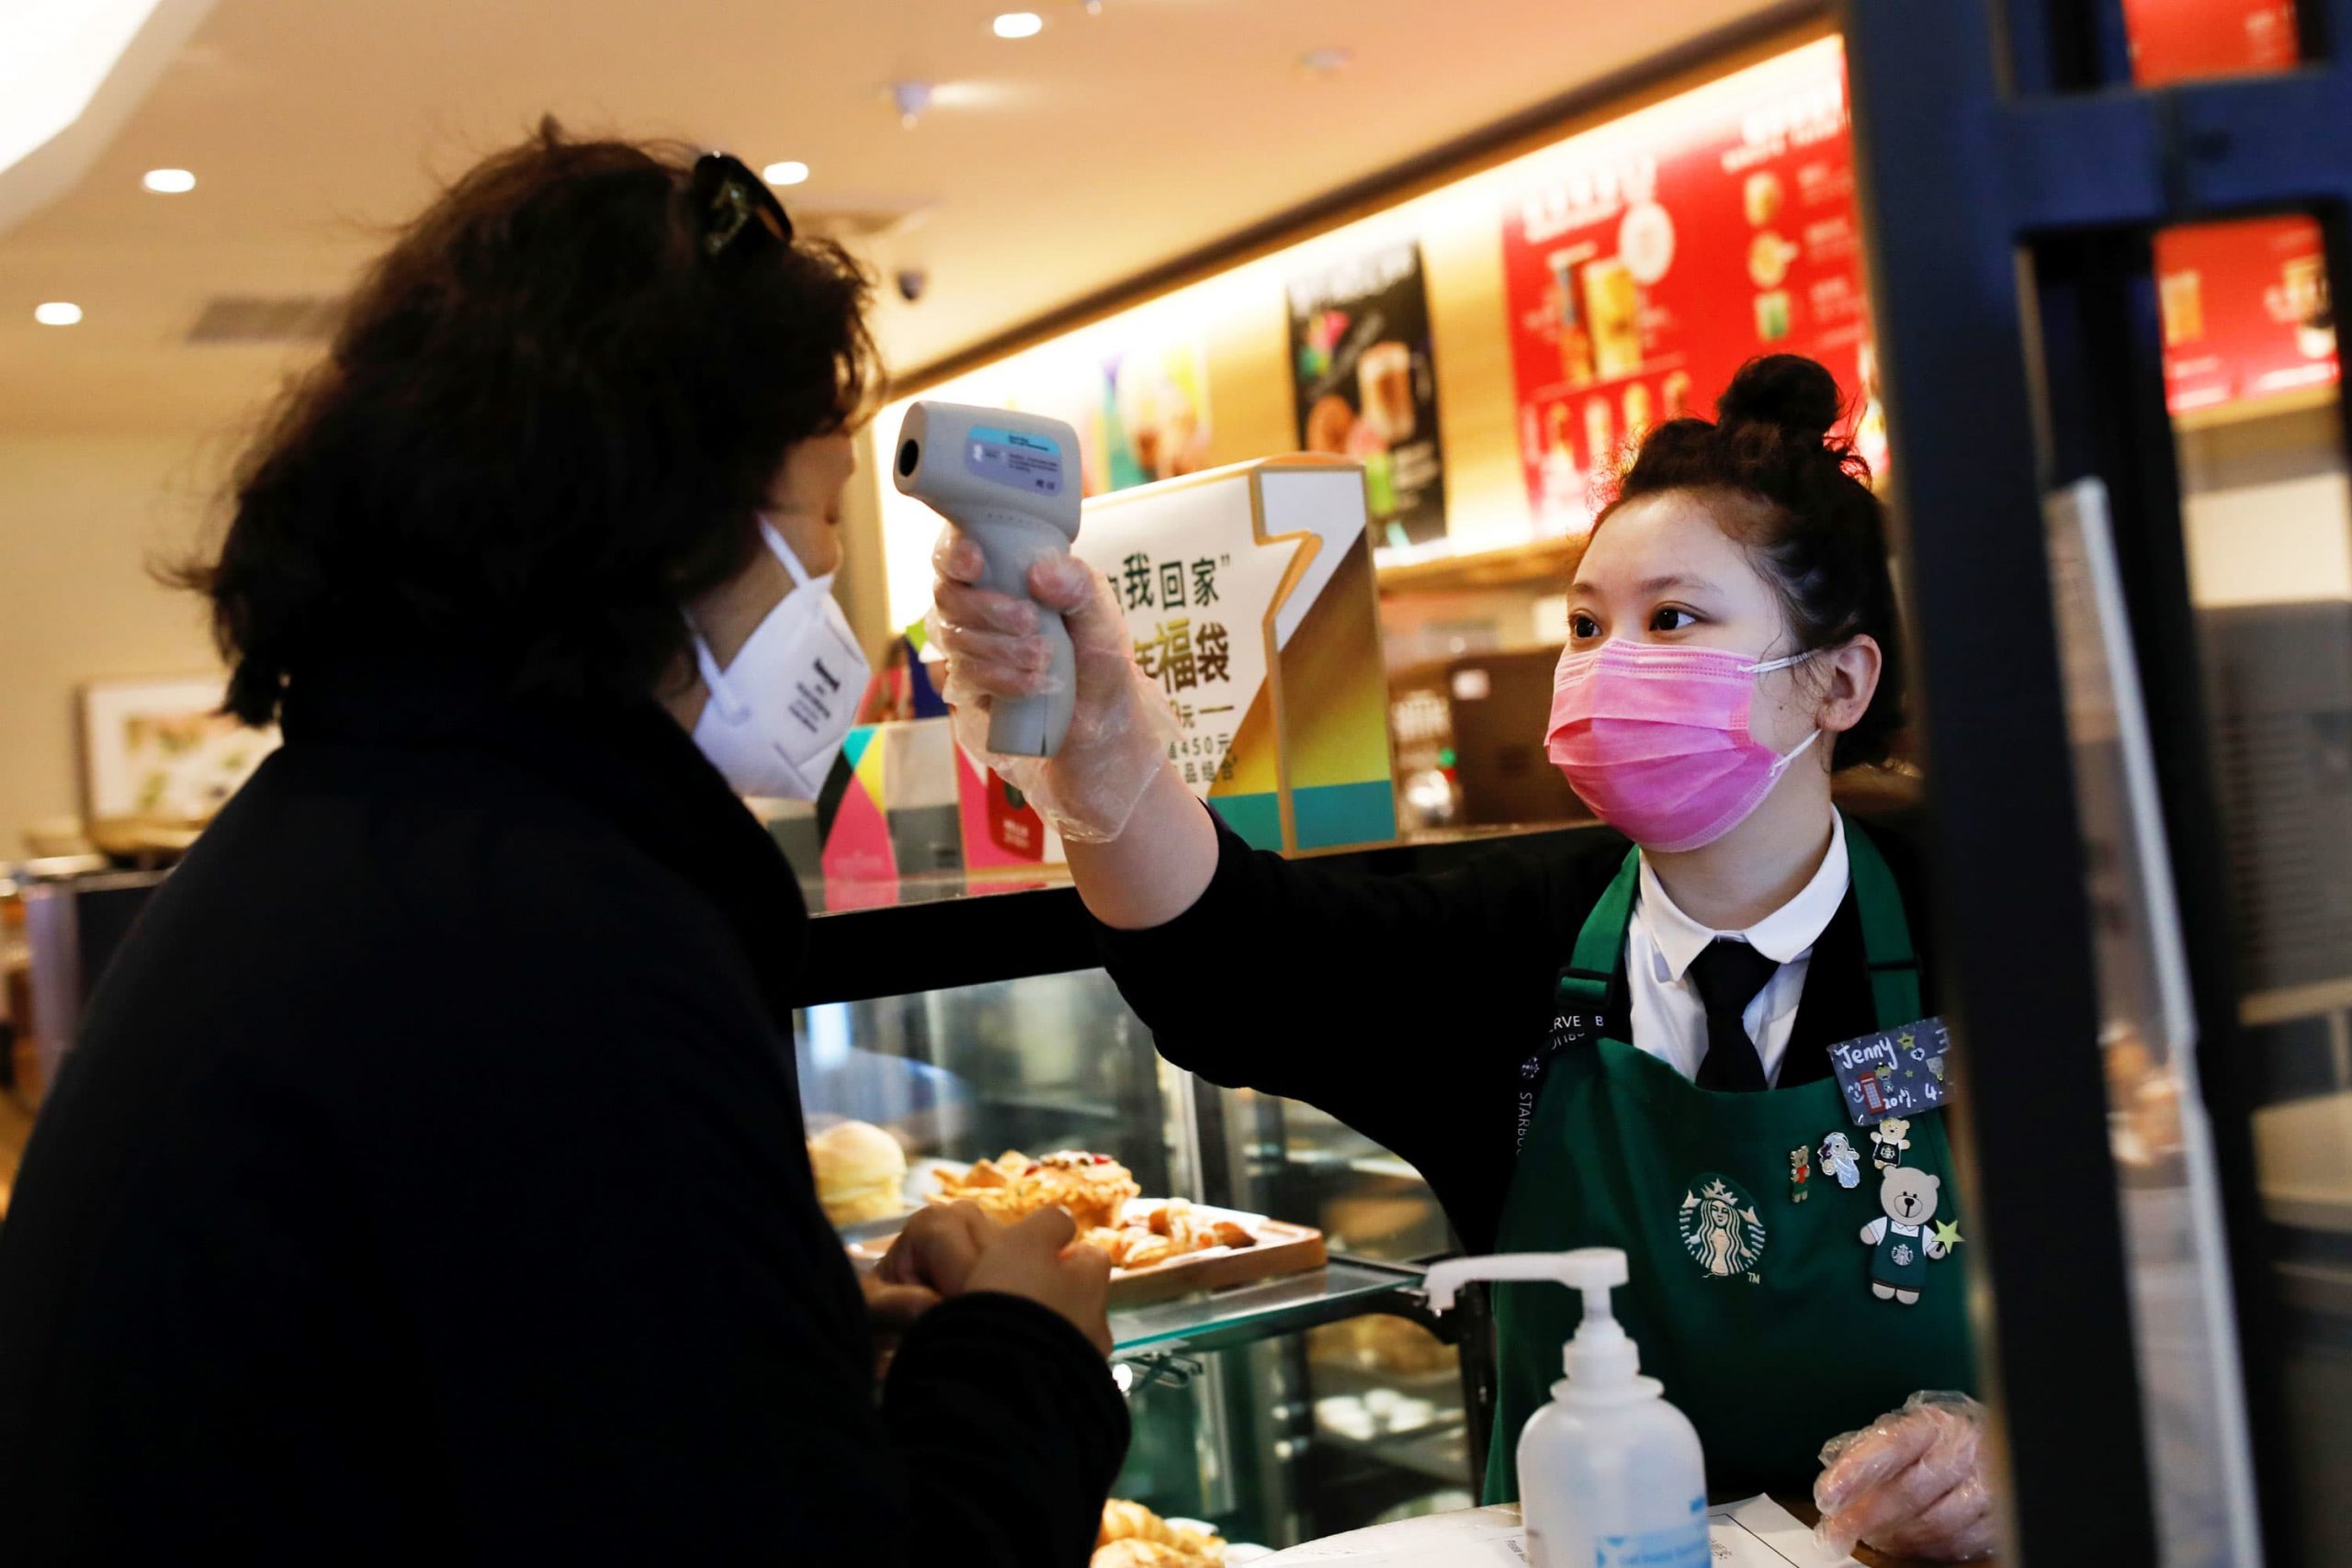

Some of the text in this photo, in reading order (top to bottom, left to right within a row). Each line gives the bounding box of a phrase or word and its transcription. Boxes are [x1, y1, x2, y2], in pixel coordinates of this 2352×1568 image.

[1107, 553, 1230, 616] 我回家”
[1549, 1015, 1581, 1033] RVE
[1834, 1036, 1898, 1070] Jenny
[1747, 1271, 1760, 1285] TM
